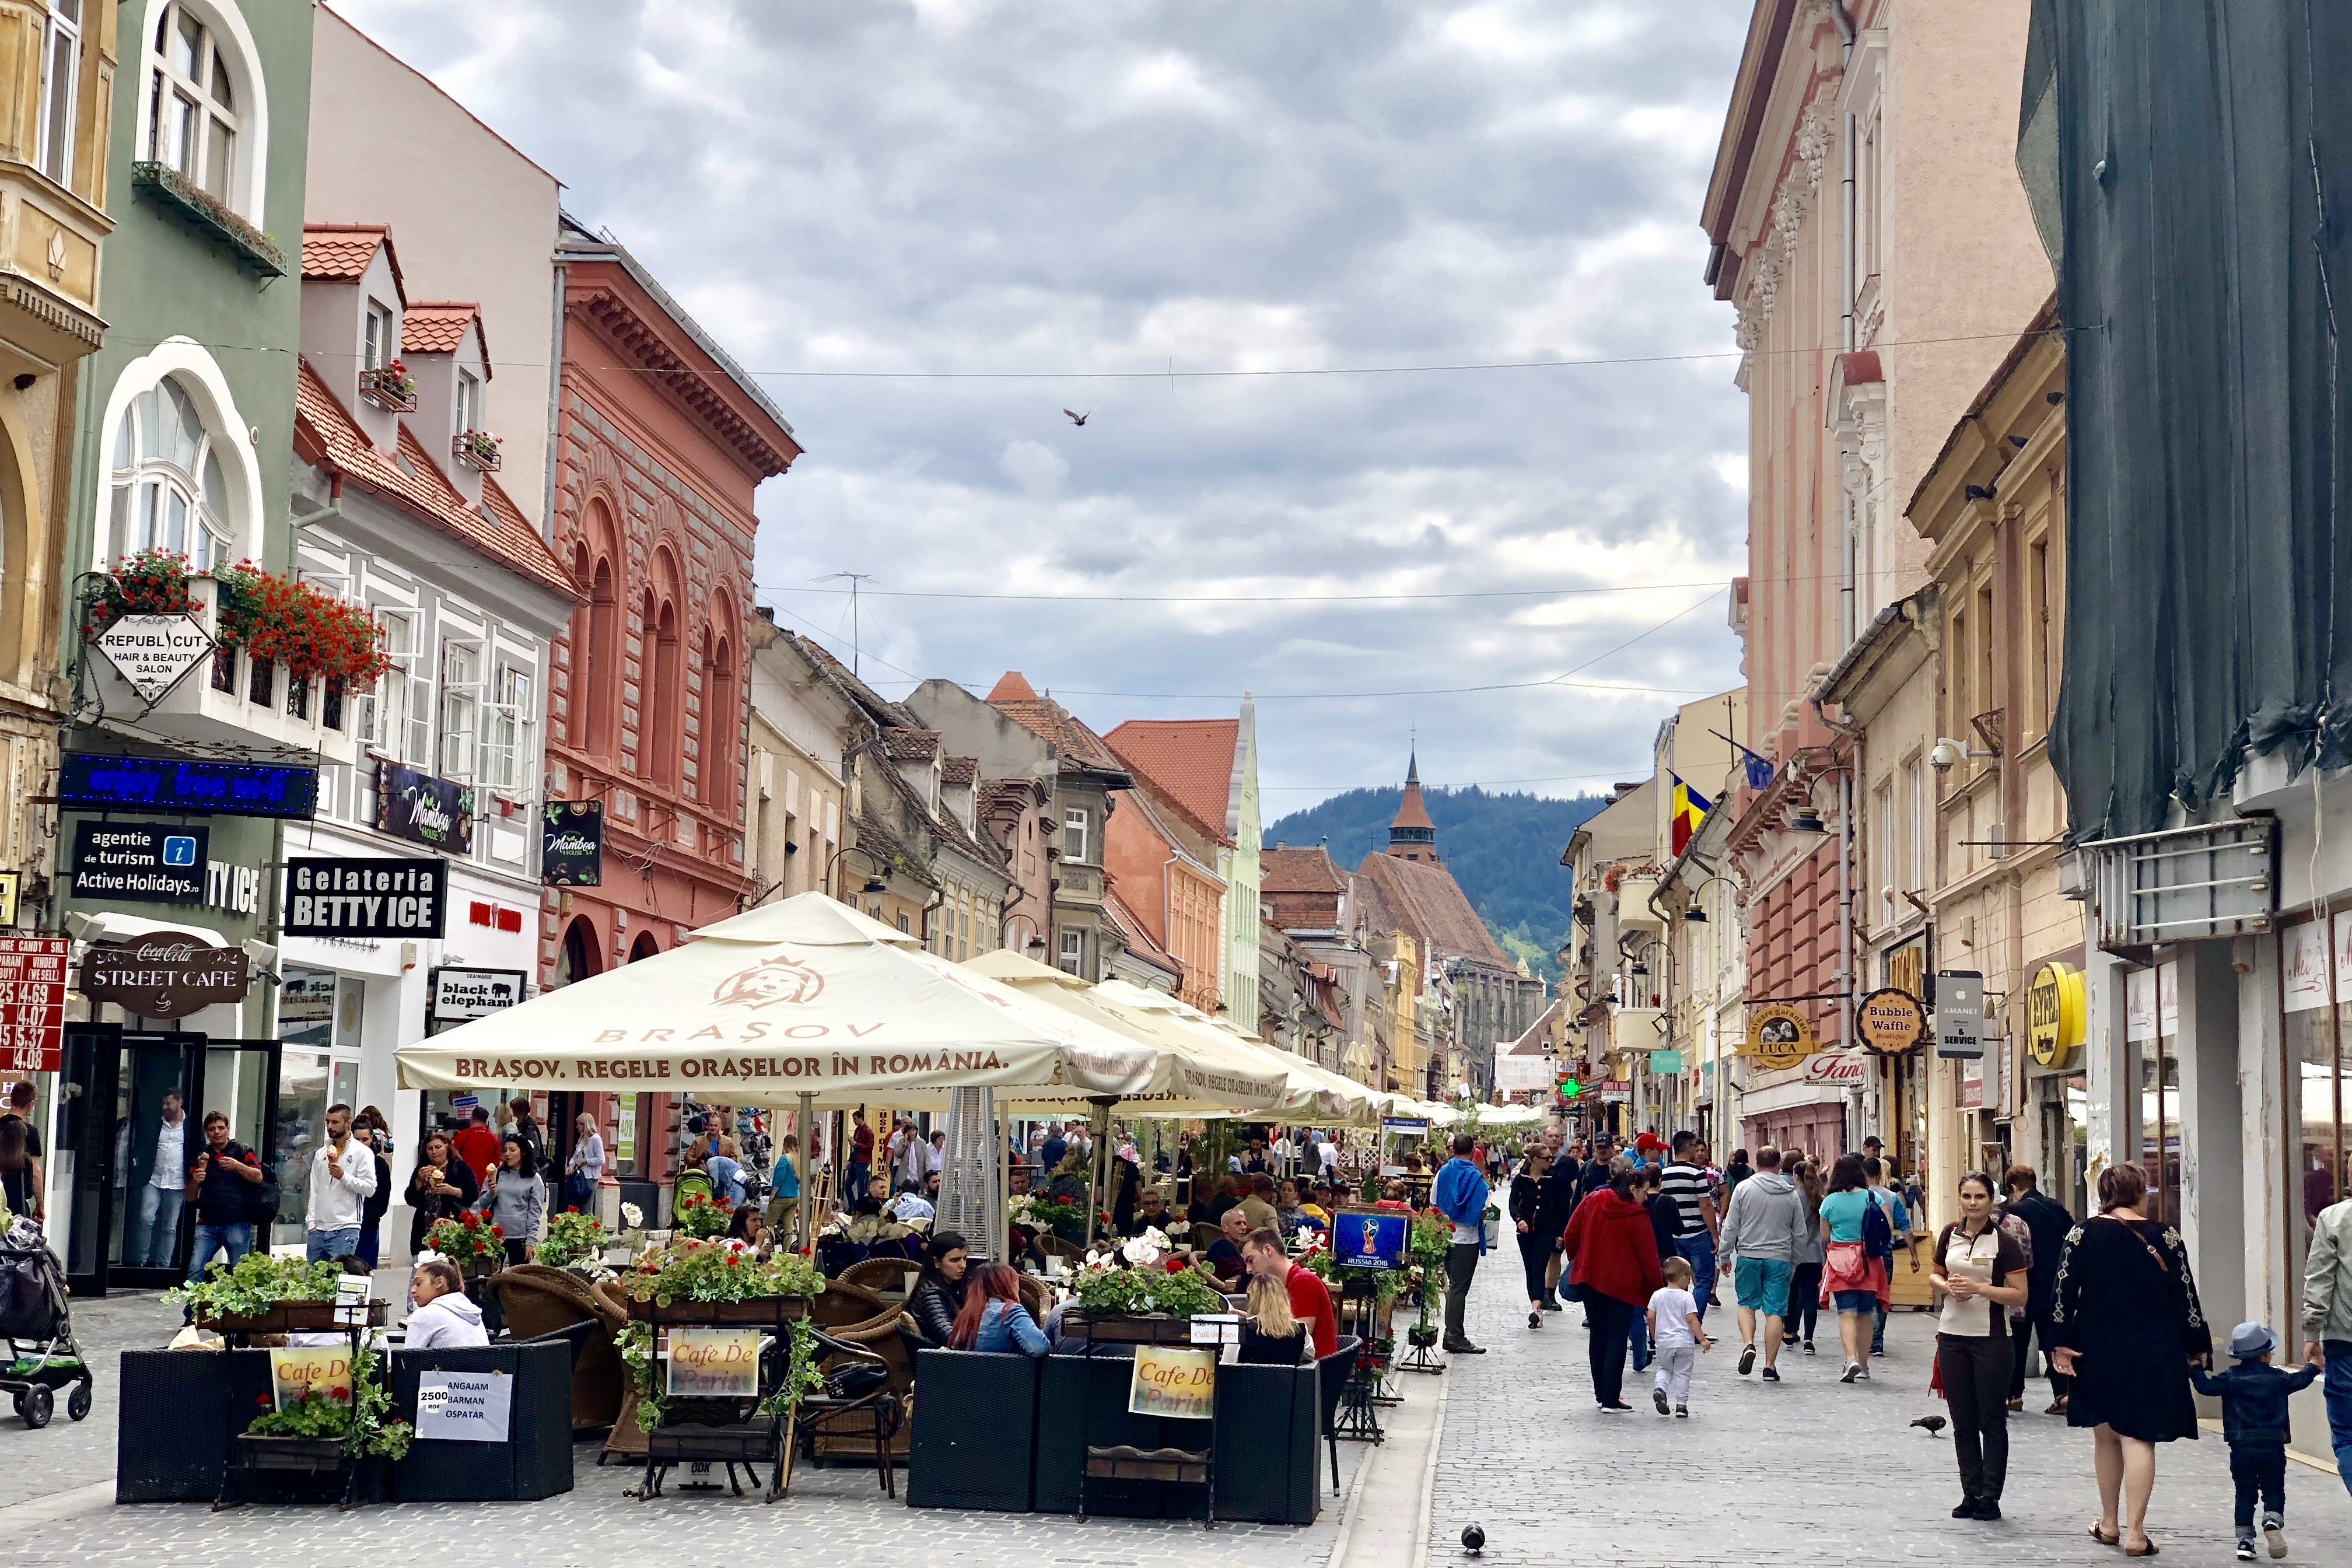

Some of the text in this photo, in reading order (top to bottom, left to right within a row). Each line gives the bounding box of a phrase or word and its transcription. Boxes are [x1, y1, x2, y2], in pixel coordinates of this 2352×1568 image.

[114, 653, 195, 662] HAIR & BEAUTY
[136, 664, 172, 673] SALON
[89, 762, 286, 801] enjoy free wi-fi
[408, 786, 450, 832] Mamboa
[92, 832, 150, 847] agentie
[545, 834, 596, 853] Mamboa
[84, 851, 155, 866] de turism
[77, 872, 123, 890] Active
[297, 867, 433, 891] Gelateria
[233, 866, 260, 914] ICE
[293, 895, 382, 927] BETTY
[387, 897, 432, 928] ICE
[19, 940, 43, 953] CANDY
[51, 942, 64, 953] SRL
[137, 943, 192, 963] Coca-Cola
[33, 956, 58, 969] VINDEM
[93, 970, 237, 987] STREET CAFE
[20, 984, 48, 1005] 4,69
[443, 983, 488, 995] black
[442, 995, 513, 1008] elephant
[2032, 983, 2058, 1027] EYFEL
[18, 1005, 47, 1027] 4,07
[1870, 1007, 1913, 1017] Bubble
[593, 1021, 886, 1043] BRAȘOV
[1871, 1021, 1911, 1031] Waffle
[17, 1027, 45, 1049] 5,37
[1944, 1036, 1977, 1045] SERVICE
[1760, 1044, 1797, 1054] LUCA
[15, 1049, 43, 1070] 4,08
[455, 1048, 1009, 1083] BRAȘOV. REGELE ORAȘELOR ÎN ROMÂNIA.
[1208, 1074, 1226, 1091] REGELE
[723, 1345, 752, 1363] De
[277, 1362, 321, 1383] Cafe
[1139, 1363, 1214, 1388] Cafe De
[448, 1382, 488, 1391] ANGAJAM
[421, 1392, 484, 1405] 2500 BARMAN
[446, 1410, 484, 1419] OSPATAR
